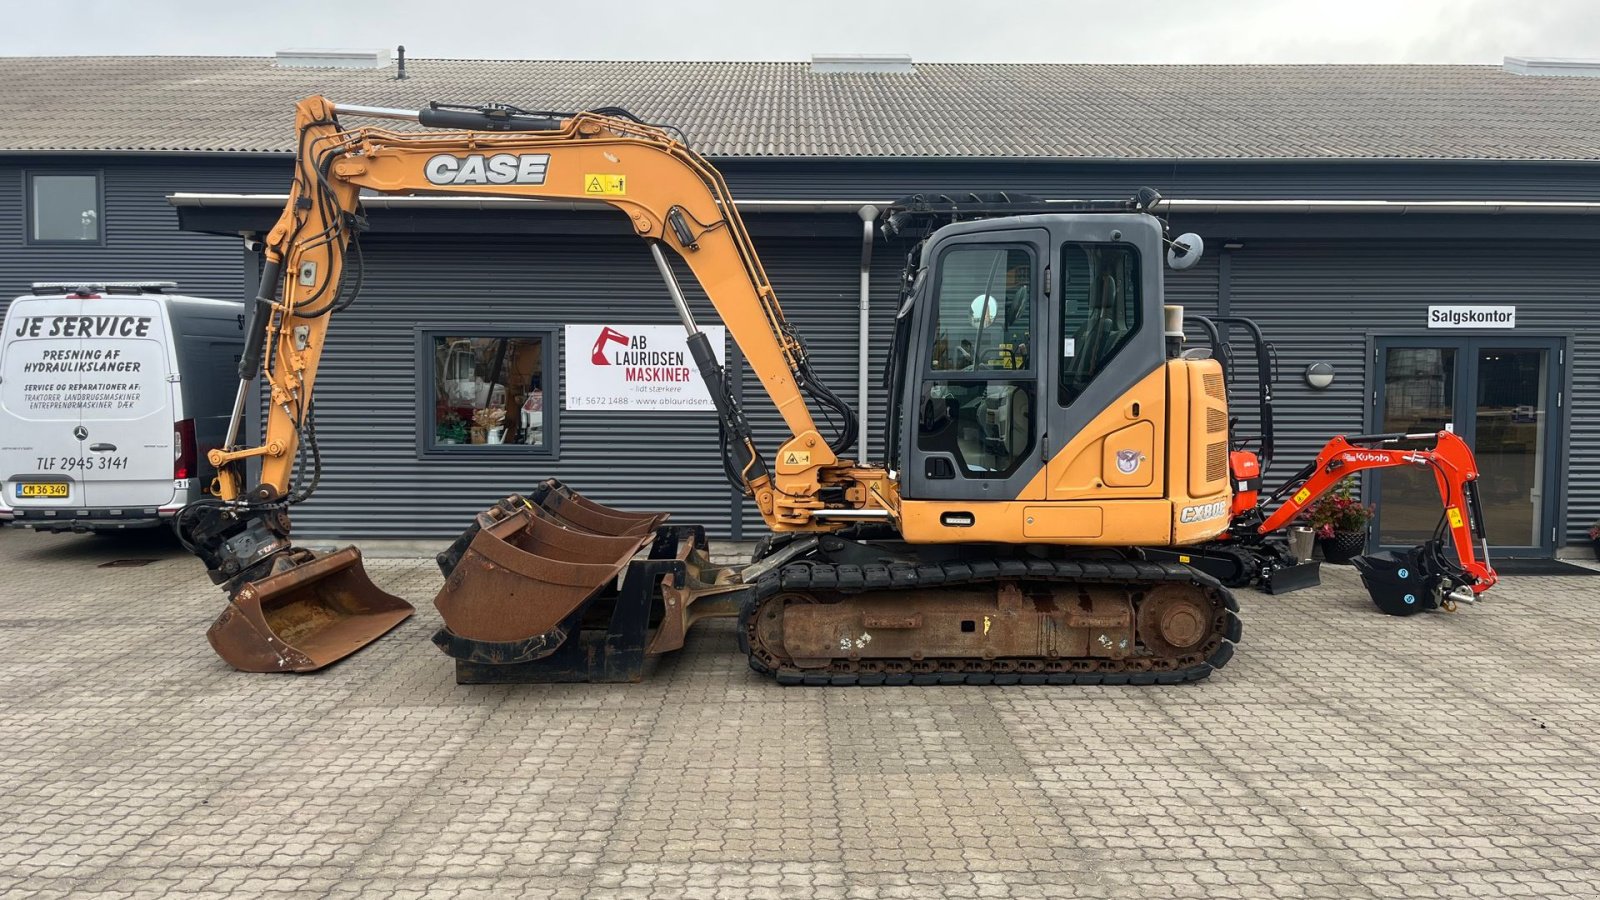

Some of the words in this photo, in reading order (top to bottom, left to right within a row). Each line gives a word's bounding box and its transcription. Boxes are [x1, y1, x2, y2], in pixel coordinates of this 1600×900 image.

[424, 153, 551, 185] CASE
[1431, 309, 1513, 325] Salgskontor
[16, 317, 44, 337] JE
[49, 316, 152, 338] SERVICE
[630, 335, 647, 350] AB
[42, 349, 102, 360] PRESNING
[104, 349, 121, 360] AF
[615, 351, 684, 366] LAURIDSEN
[24, 361, 141, 373] HYDRAULIKSLANGER
[625, 367, 690, 382] MASKINER
[24, 383, 54, 391] SERVICE
[56, 383, 66, 391] OG
[68, 383, 127, 391] REPARATIONER
[635, 385, 648, 393] lidt
[649, 385, 682, 393] stærkere
[24, 393, 61, 401] TRAKTORER
[64, 393, 141, 401] LANDBRUGSMASKINER
[585, 397, 606, 405] 5672
[609, 397, 629, 405] 1488
[30, 401, 113, 409] ENTREPRENØRMASKINER
[117, 401, 134, 409] DÆK
[1355, 452, 1390, 462] Kubota
[37, 457, 57, 470] TLF
[60, 456, 94, 471] 2945
[98, 456, 128, 470] 3141
[23, 485, 35, 495] CM
[36, 485, 47, 495] 36
[49, 485, 66, 495] 349
